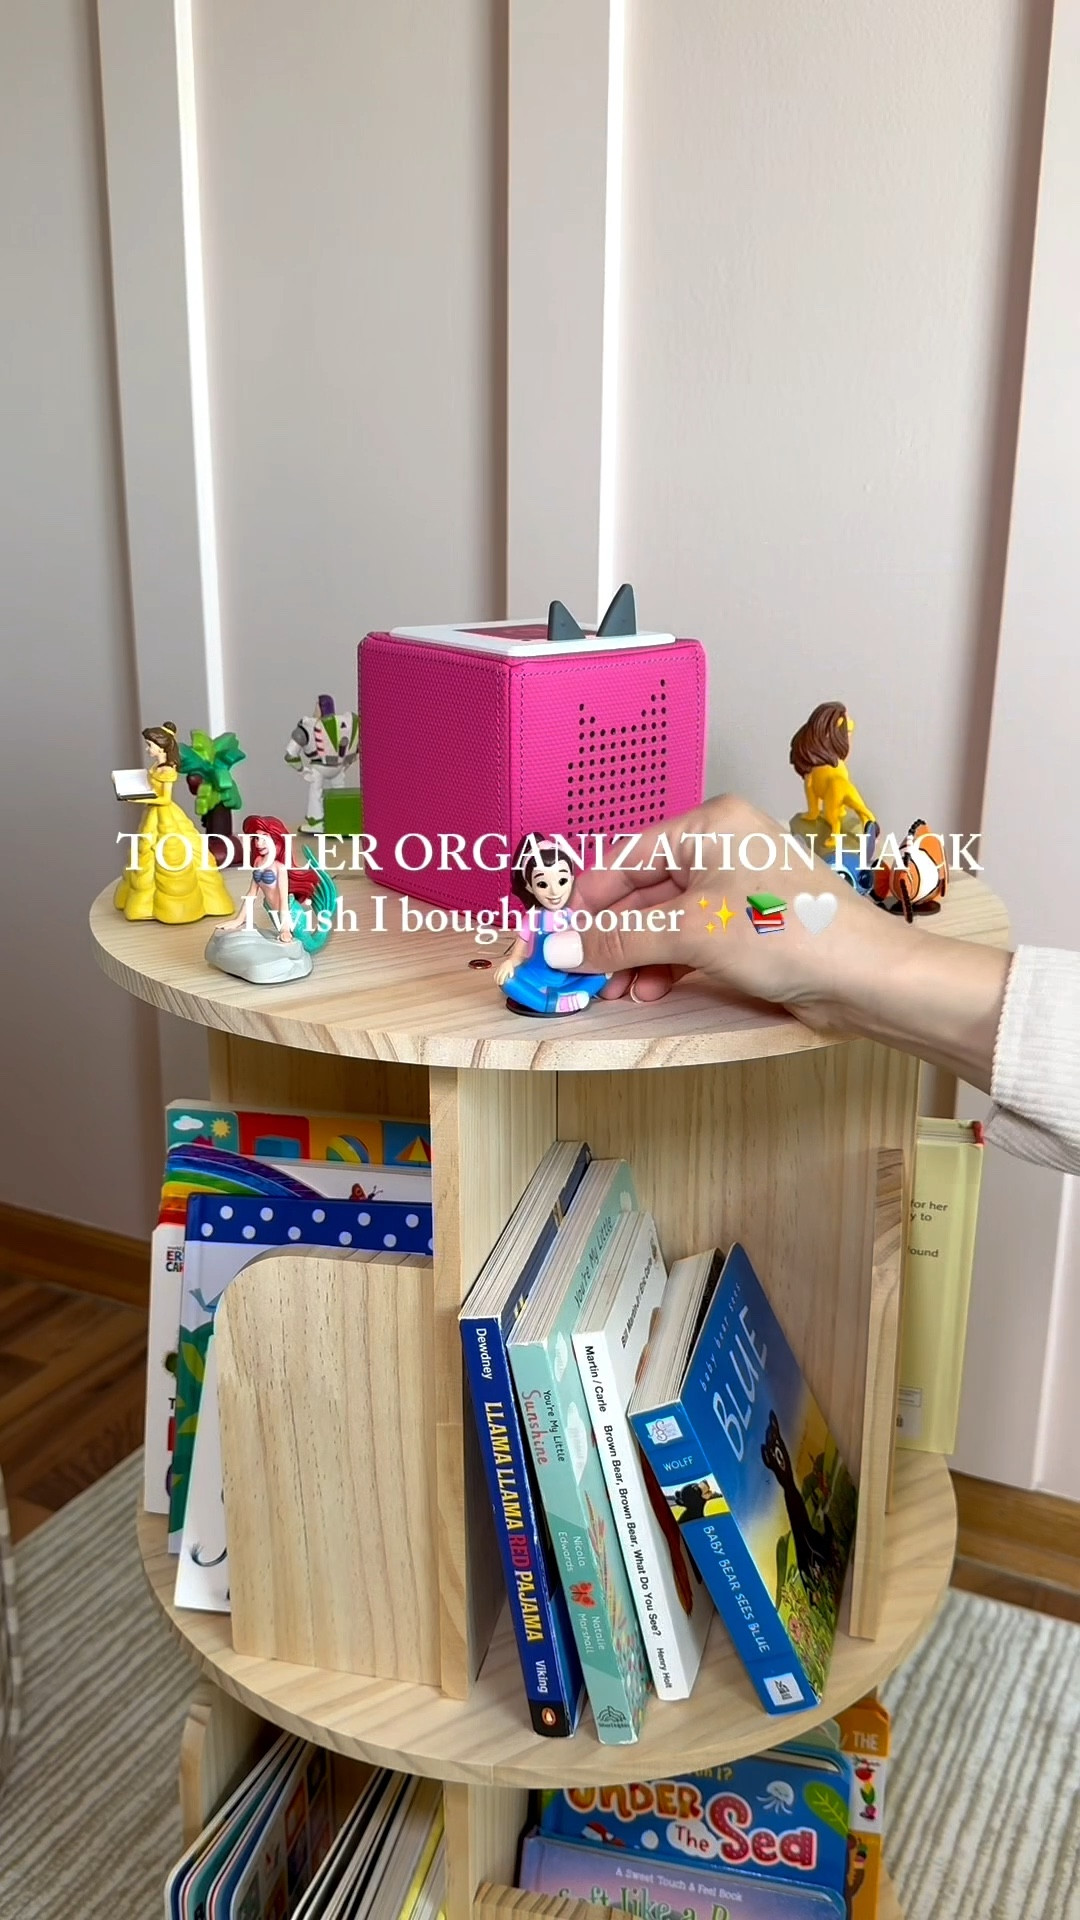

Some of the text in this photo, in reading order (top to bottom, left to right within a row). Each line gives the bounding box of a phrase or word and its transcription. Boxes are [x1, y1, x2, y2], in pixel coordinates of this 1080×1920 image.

[920, 1213, 932, 1222] to
[929, 1201, 948, 1211] her
[588, 1247, 600, 1268] My
[908, 1246, 939, 1258] ound
[476, 1328, 493, 1380] Dewdney
[700, 1353, 718, 1392] baby
[716, 1315, 730, 1349] bear
[585, 1345, 599, 1378] Martin
[594, 1385, 607, 1412] Carle
[713, 1305, 768, 1462] BLUE
[522, 1389, 549, 1466] Sunshine
[543, 1389, 565, 1462] You're My Little
[662, 1456, 693, 1471] WOLFF
[484, 1402, 545, 1642] LLAMA LLAMA RED PAJAMA
[604, 1425, 662, 1637] Brown Bear, Brown Bear, What Do You See?
[558, 1531, 574, 1573] Edwards
[573, 1535, 586, 1568] Nicola
[703, 1525, 771, 1653] BABY BEAR SEES BLUE
[577, 1613, 595, 1654] Marshall
[592, 1616, 605, 1650] Natalie
[535, 1660, 548, 1694] Viking
[657, 1647, 673, 1689] Henry Holt
[675, 1793, 816, 1870] The Sea
[656, 1875, 686, 1890] Touch
[719, 1888, 743, 1902] Book
